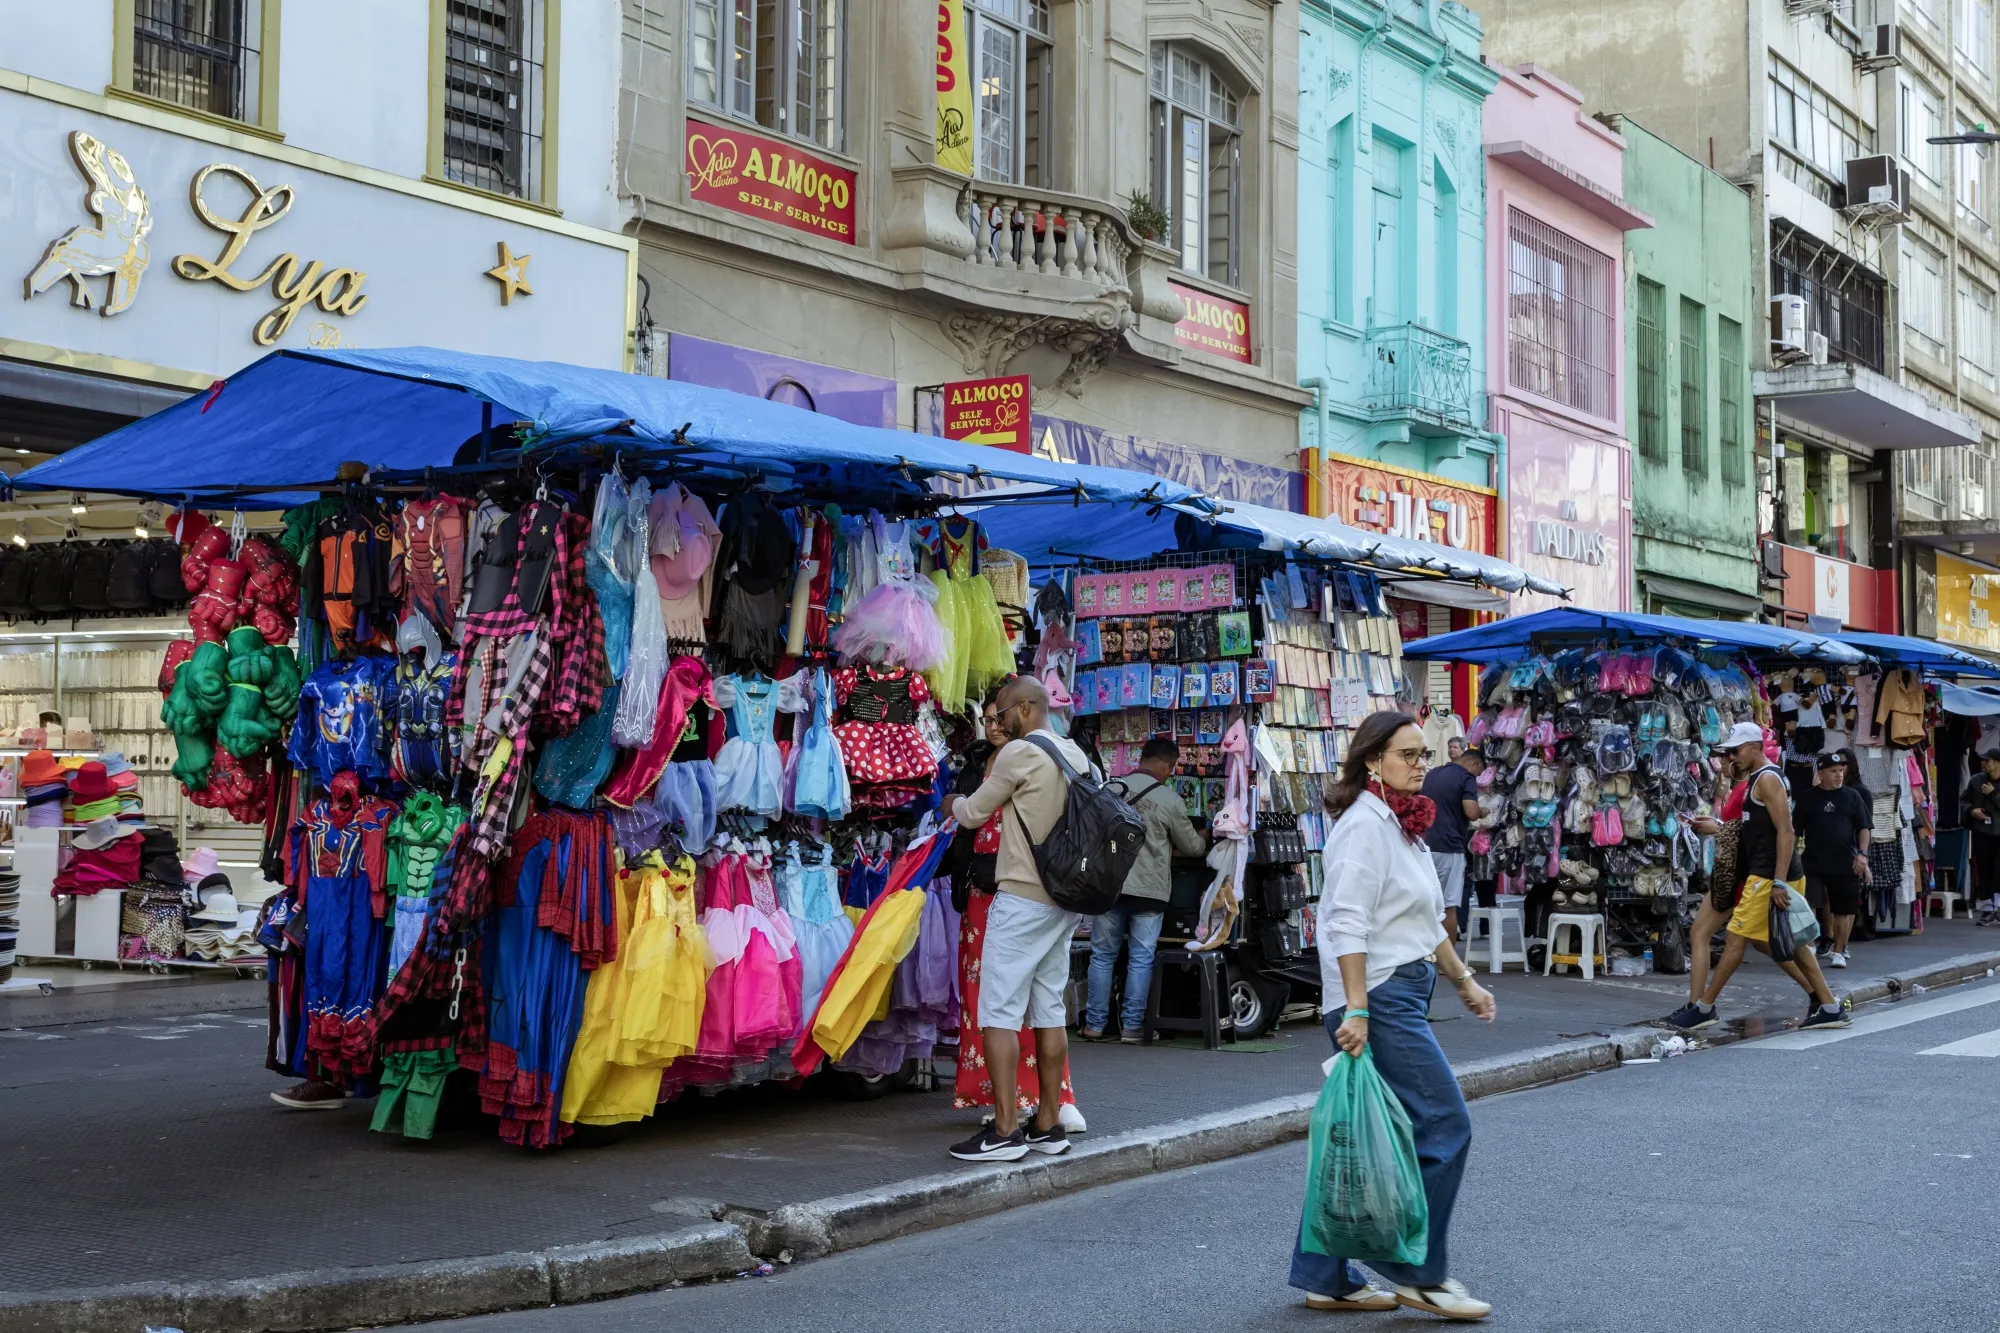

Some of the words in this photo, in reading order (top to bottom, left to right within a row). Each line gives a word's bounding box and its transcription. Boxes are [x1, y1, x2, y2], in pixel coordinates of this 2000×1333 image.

[741, 147, 849, 213] ALMOÇO
[737, 191, 784, 213] SELF
[785, 205, 849, 235] SERVICE
[171, 163, 369, 345] Lya
[1181, 296, 1246, 340] LMOÇO
[1174, 327, 1199, 342] SELF
[1201, 335, 1247, 356] SERVICE
[950, 382, 1024, 404] ALMOÇO
[950, 417, 992, 430] SERVICE
[959, 409, 983, 420] SELF
